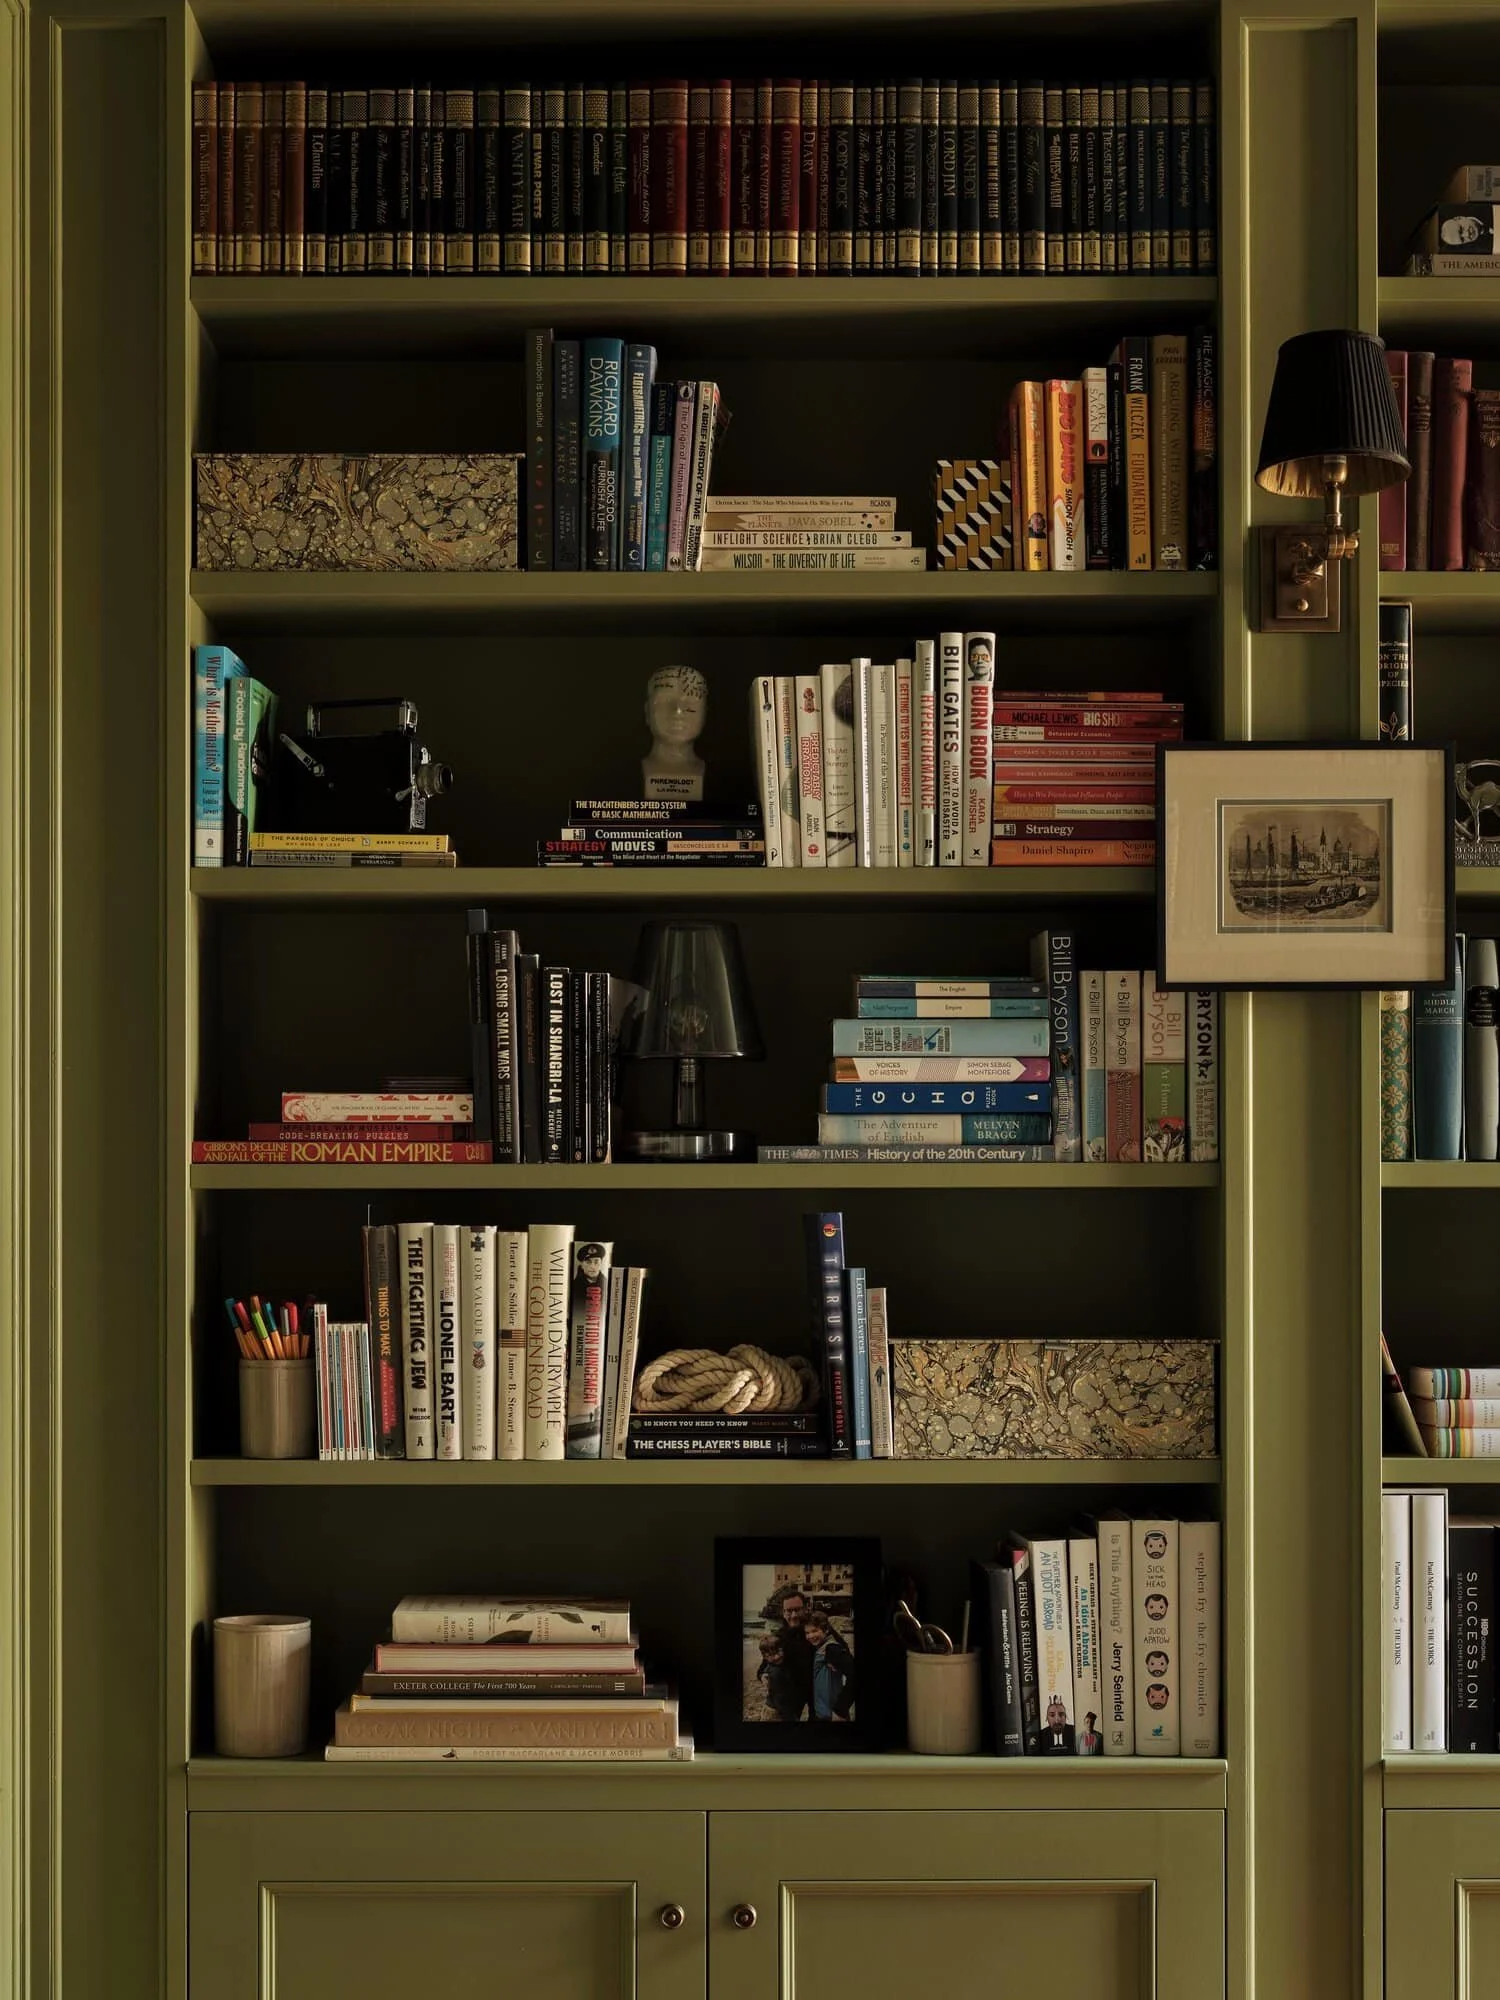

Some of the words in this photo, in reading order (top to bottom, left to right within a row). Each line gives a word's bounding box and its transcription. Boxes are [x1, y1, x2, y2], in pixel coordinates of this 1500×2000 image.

[533, 152, 542, 177] WAR
[942, 130, 956, 172] LORD
[963, 130, 976, 200] IVANHOE
[942, 174, 956, 196] JIM
[1103, 178, 1114, 213] ISLAND
[533, 182, 542, 219] POETS
[536, 335, 544, 381] Information
[1129, 357, 1142, 392] FRANK
[536, 392, 544, 428] Beautiful
[589, 357, 603, 437] DAWKINS
[604, 360, 618, 435] RICHARD
[700, 412, 708, 439] BRIEF
[1131, 396, 1144, 440] WILCZEK
[656, 439, 666, 456] The
[696, 441, 706, 481] HISTORY
[597, 460, 606, 501] FURNISH
[606, 470, 615, 506] BOOKS
[655, 459, 664, 488] Selfish
[696, 482, 704, 495] OF
[654, 490, 662, 514] Gene
[694, 498, 702, 520] TIME
[1065, 488, 1073, 518] SIMON
[1132, 453, 1146, 536] FUNDAMENTALS
[597, 512, 606, 532] LIFE
[606, 508, 615, 522] DO
[714, 534, 757, 544] INFLIGHT
[763, 534, 803, 544] SCIENCE
[814, 534, 842, 544] BRIAN
[847, 534, 878, 544] CLEGG
[1065, 522, 1073, 550] SINGH
[734, 554, 762, 568] WILSON
[773, 554, 786, 568] THE
[789, 554, 828, 568] DIVERSITY
[830, 554, 840, 568] OF
[841, 554, 856, 568] LIFE
[206, 656, 220, 683] What
[944, 646, 958, 687] BILL
[206, 687, 220, 696] is
[236, 690, 246, 726] Fooled
[944, 692, 958, 754] GATES
[970, 685, 988, 733] BURN
[1012, 712, 1048, 724] MICHAEL
[1052, 712, 1078, 724] LEWIS
[206, 700, 220, 772] Mathematics?
[234, 728, 246, 740] by
[800, 736, 812, 797] IRRATIONAL
[811, 732, 822, 800] PREDICTABLY
[920, 694, 934, 810] HYPERFORMANCE
[970, 735, 988, 780] BOOK
[236, 742, 246, 808] Randomness
[942, 760, 950, 796] CLIMATE
[576, 801, 588, 810] THE
[588, 801, 639, 810] TRACHTENBERG
[640, 801, 660, 810] SPEED
[661, 801, 686, 810] SYSTEM
[952, 788, 958, 798] TO
[592, 811, 601, 820] OF
[602, 811, 621, 820] BASIC
[622, 811, 670, 820] MATHEMATICS
[942, 798, 950, 840] DISASTER
[968, 788, 977, 833] SWISHER
[978, 798, 986, 824] KARA
[594, 829, 682, 840] Communication
[1025, 824, 1074, 836] Strategy
[546, 840, 607, 852] STRATEGY
[611, 840, 655, 852] MOVES
[1051, 936, 1071, 966] Bill
[495, 969, 508, 1008] LOSING
[549, 974, 562, 1006] LOST
[549, 1010, 562, 1024] IN
[1050, 970, 1073, 1043] Bryson
[497, 1012, 509, 1048] SMALL
[498, 1050, 510, 1080] WARS
[548, 1028, 562, 1104] SHANGRI-LA
[280, 1132, 359, 1140] CODE-BREAKING
[366, 1132, 409, 1140] PUZZLES
[854, 1120, 876, 1129] The
[880, 1120, 938, 1129] Adventure
[868, 1132, 878, 1141] of
[884, 1132, 924, 1144] English
[973, 1121, 1020, 1129] MELVYN
[977, 1130, 1016, 1139] BRAGG
[203, 1143, 248, 1152] GIBBON'S
[250, 1143, 288, 1152] DECLINE
[204, 1152, 226, 1162] AND
[227, 1152, 250, 1162] FALL
[252, 1152, 266, 1162] OF
[266, 1152, 287, 1162] THE
[291, 1144, 378, 1162] ROMAN
[383, 1144, 452, 1162] EMPIRE
[765, 1150, 790, 1159] THE
[823, 1150, 858, 1159] TIMES
[868, 1150, 910, 1160] History
[913, 1150, 925, 1159] of
[927, 1150, 946, 1159] the
[948, 1150, 974, 1159] 20th
[976, 1150, 1024, 1160] Century
[408, 1238, 422, 1268] THE
[508, 1242, 518, 1268] Heart
[508, 1272, 518, 1280] of
[532, 1260, 542, 1280] THE
[548, 1248, 564, 1324] WILLIAM
[408, 1272, 425, 1352] FIGHTING
[508, 1292, 518, 1326] Soldier
[528, 1286, 544, 1358] GOLDEN
[824, 1256, 842, 1361] THRUST
[440, 1301, 454, 1370] LIONEL
[410, 1358, 426, 1390] JEW
[547, 1330, 564, 1429] DALRYMPLE
[441, 1372, 454, 1424] BART
[528, 1364, 544, 1419] ROAD
[634, 1440, 654, 1449] THE
[656, 1440, 690, 1449] CHESS
[692, 1440, 740, 1449] PLAYER'S
[743, 1440, 772, 1449] BIBLE
[1426, 1561, 1434, 1575] Paul
[1018, 1580, 1030, 1617] PEEING
[1081, 1588, 1090, 1602] An
[1425, 1576, 1434, 1611] McCartney
[1020, 1620, 1030, 1629] IS
[1082, 1604, 1090, 1628] Idiot
[1481, 1618, 1489, 1636] HBO
[1082, 1632, 1090, 1667] Abroad
[1426, 1628, 1434, 1642] THE
[1466, 1572, 1478, 1710] SUCCESSION
[1021, 1631, 1033, 1682] RELIEVING
[1110, 1642, 1124, 1672] Jerry
[1426, 1642, 1434, 1666] LYRICS
[392, 1682, 428, 1690] EXETER
[430, 1682, 471, 1690] COLLEGE
[1112, 1675, 1124, 1722] Seinfeld
